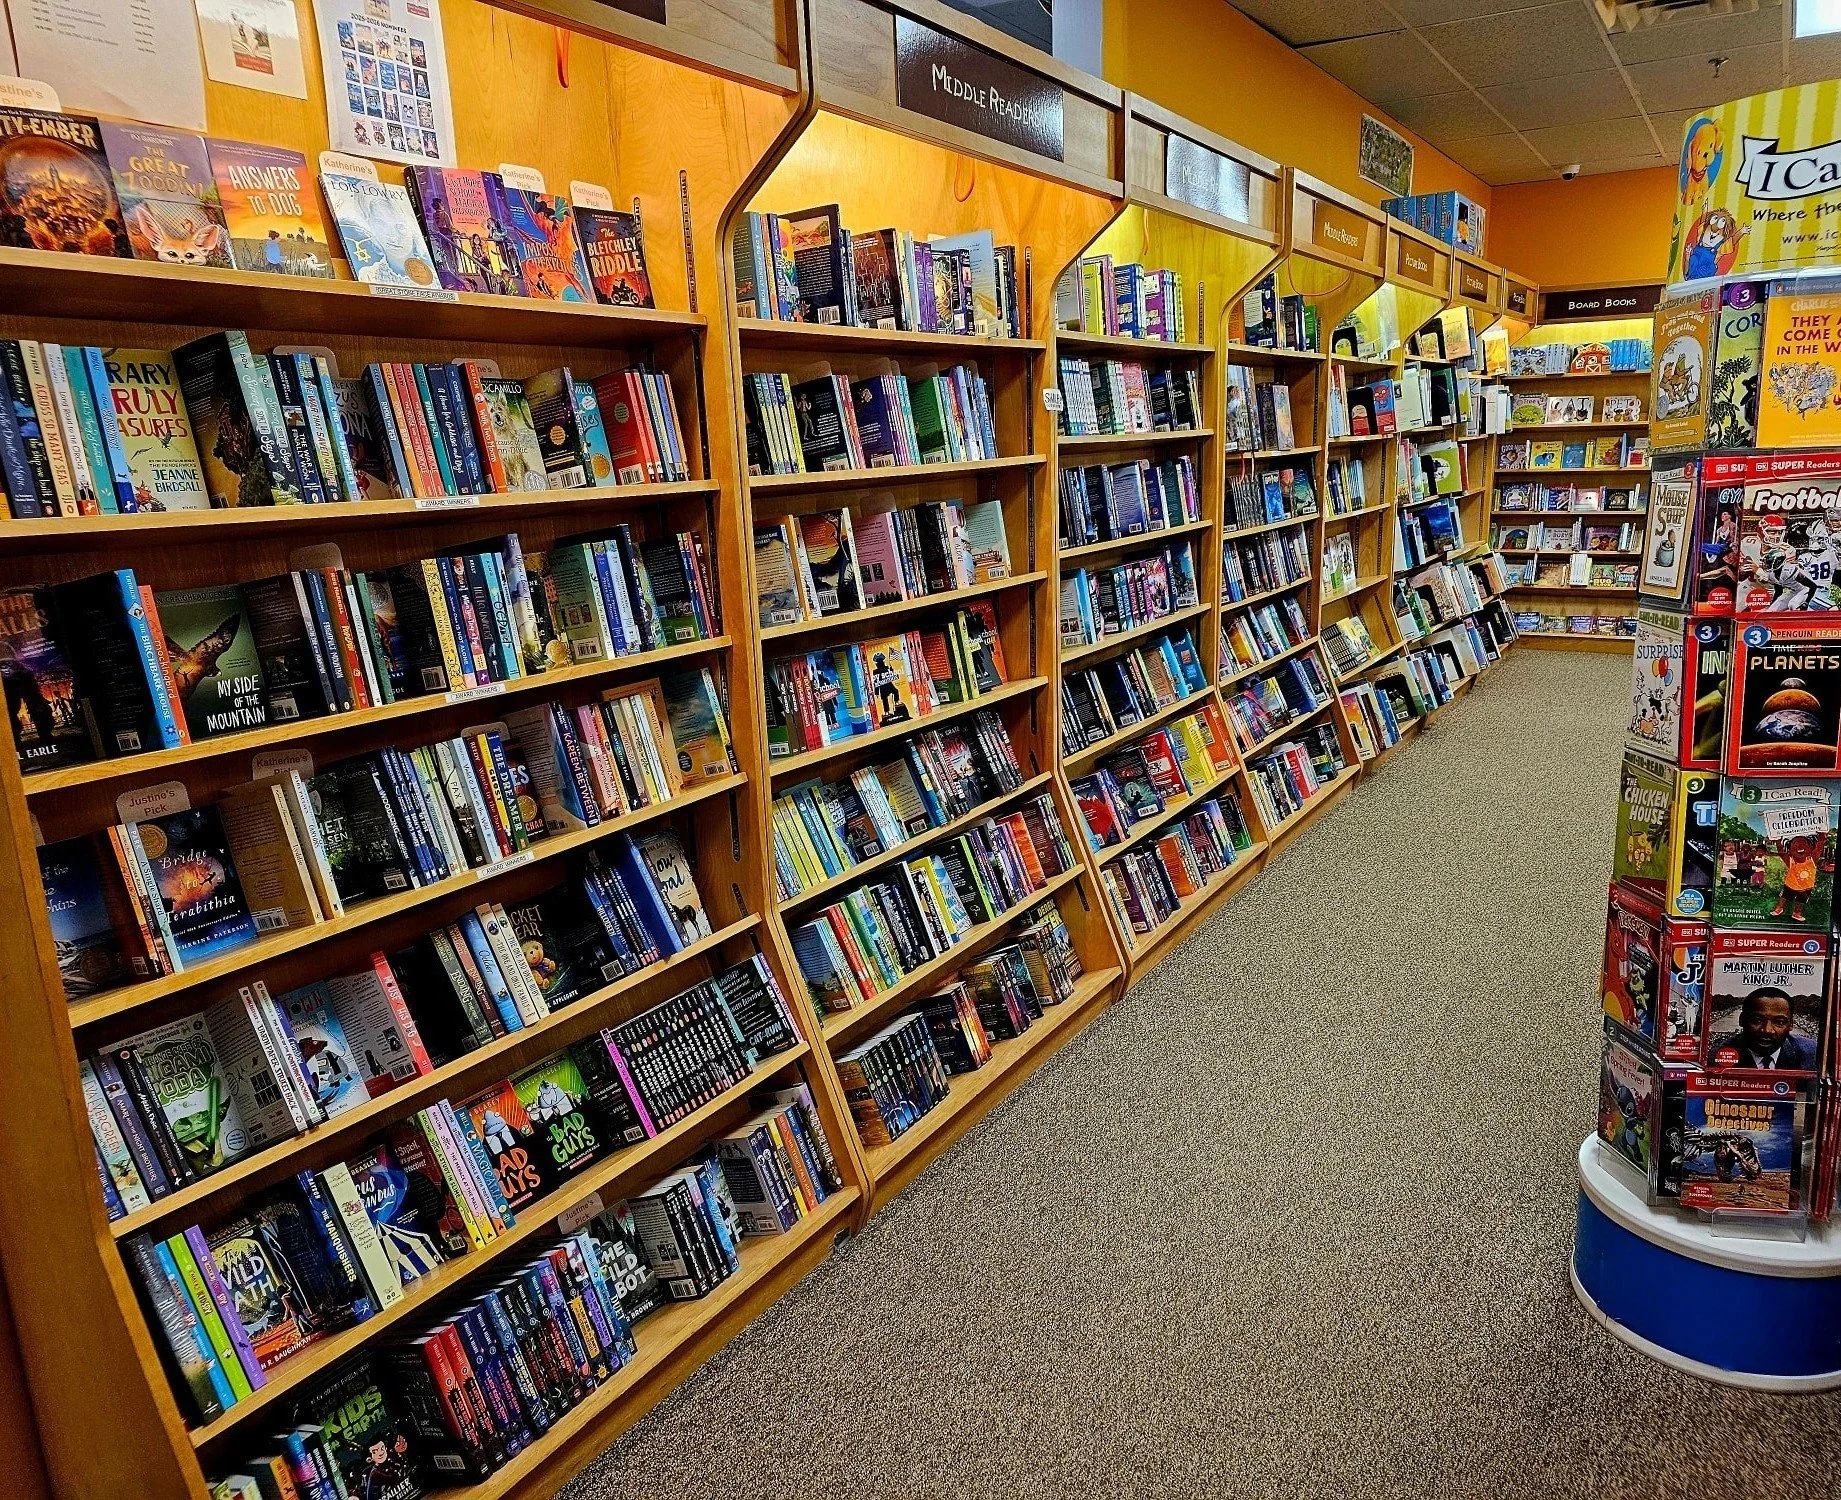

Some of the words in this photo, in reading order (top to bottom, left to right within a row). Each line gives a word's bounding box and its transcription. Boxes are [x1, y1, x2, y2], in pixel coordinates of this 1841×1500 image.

[932, 63, 986, 109] MIDDLE
[989, 85, 1041, 128] READERS
[30, 117, 99, 150] EMBER
[146, 145, 165, 158] THE
[128, 155, 190, 179] GREAT
[322, 157, 374, 175] Katherine's
[501, 168, 541, 183] Katherine's
[1757, 161, 1779, 193] I
[1783, 157, 1841, 191] Ca
[228, 165, 301, 192] ANSWERS
[329, 179, 360, 194] LOIS
[362, 182, 408, 202] LOWRY
[572, 184, 609, 201] Katherine's
[247, 195, 267, 216] TO
[266, 191, 303, 217] DOG
[585, 198, 601, 209] Pick
[1752, 209, 1808, 222] Where
[600, 227, 616, 239] The
[1323, 221, 1342, 242] MIDDLE
[1340, 228, 1359, 248] READERS
[586, 236, 637, 256] BLETCHLEY
[591, 250, 644, 278] RIDDLE
[1568, 301, 1600, 310] BOARD
[1604, 298, 1637, 308] BOOKS
[1739, 289, 1750, 303] 3
[1660, 316, 1678, 336] Frog
[1667, 321, 1697, 337] Together
[1791, 315, 1831, 328] THEY
[1783, 329, 1830, 342] COME
[1776, 346, 1791, 356] IN
[1795, 344, 1819, 355] THE
[239, 352, 250, 369] BOW
[105, 361, 171, 386] RARY
[35, 383, 53, 418] ACROSS
[112, 387, 178, 415] RULY
[118, 417, 188, 438] ASURES
[48, 430, 63, 458] MANY
[54, 460, 69, 486] SEAS
[151, 468, 200, 481] JEANNE
[1755, 462, 1769, 472] DK
[1770, 460, 1804, 470] SUPER
[1806, 460, 1840, 469] Readers
[154, 480, 203, 493] BIRDSALL
[1655, 484, 1689, 508] MOUSE
[425, 499, 446, 507] AWARD
[446, 498, 472, 506] WINNERS
[1754, 486, 1841, 512] Footbal
[1655, 506, 1687, 537] SOUP
[1809, 561, 1831, 581] 38
[1700, 625, 1713, 640] 3
[1749, 630, 1762, 646] 3
[1776, 629, 1813, 638] PENGUIN
[154, 638, 177, 700] mockingbird
[1750, 655, 1840, 671] PLANETS
[141, 634, 164, 694] BIRCHBARK
[158, 692, 172, 722] HOUSE
[216, 678, 235, 699] MY
[233, 673, 260, 694] SIDE
[234, 697, 245, 709] OF
[244, 694, 260, 706] THE
[455, 690, 474, 700] AWARD
[475, 685, 498, 696] WINNERS
[206, 707, 266, 732] MOUNTAIN
[26, 744, 59, 759] EARLE
[255, 753, 310, 769] Katherine's
[489, 768, 502, 801] GHOST
[563, 732, 582, 773] KAREEM
[575, 772, 597, 819] BETWEEN
[1626, 776, 1640, 787] THE
[1690, 780, 1700, 791] 3
[128, 788, 176, 809] Justine's
[450, 780, 463, 800] PAX
[491, 745, 507, 771] THE
[499, 771, 523, 833] DREAMER
[1624, 786, 1670, 808] CHICKEN
[1747, 790, 1756, 801] 3
[1764, 790, 1769, 799] I
[1769, 789, 1792, 800] Can
[1793, 788, 1824, 798] Read!
[143, 803, 169, 818] Pick
[1629, 806, 1664, 825] HOUSE
[1778, 809, 1816, 824] FREEDOM
[1771, 815, 1825, 831] CELEBRATION
[129, 830, 143, 853] PARK
[159, 848, 208, 872] Bridge
[485, 862, 504, 875] AWARD
[504, 855, 527, 867] WINNERS
[185, 877, 199, 891] to
[165, 892, 237, 926] Terabithia
[213, 921, 250, 941] PATERSON
[1722, 938, 1736, 947] DK
[1737, 938, 1768, 948] SUPER
[1768, 941, 1801, 949] Readers
[1722, 961, 1768, 974] MARTIN
[1769, 963, 1814, 976] LUTHER
[1742, 974, 1772, 987] KING
[1773, 976, 1793, 987] JR.
[552, 989, 579, 1007] APPLEGATE
[765, 1022, 782, 1040] RUN
[1695, 1077, 1708, 1086] DK
[1708, 1077, 1740, 1088] SUPER
[1740, 1081, 1771, 1090] Readers
[473, 1097, 501, 1115] BLABEY
[1704, 1098, 1776, 1120] Dinosaur
[93, 1096, 122, 1156] EVERGREEN
[458, 1112, 470, 1130] BELL
[549, 1112, 586, 1144] BAD
[1707, 1115, 1771, 1132] Detectives
[551, 1126, 596, 1164] GUYS
[351, 1157, 378, 1176] BEASLEY
[320, 1209, 330, 1221] THE
[564, 1199, 594, 1222] Justine's
[575, 1213, 591, 1226] Pick
[324, 1218, 357, 1283] VANQUISHERS
[614, 1264, 647, 1300] BOT
[234, 1274, 276, 1313] ATH
[610, 1293, 626, 1321] DUET
[630, 1301, 654, 1319] BROWN
[274, 1336, 312, 1363] BAUGHMAN
[321, 1384, 383, 1440] KIDS
[342, 1404, 388, 1441] EARTH
